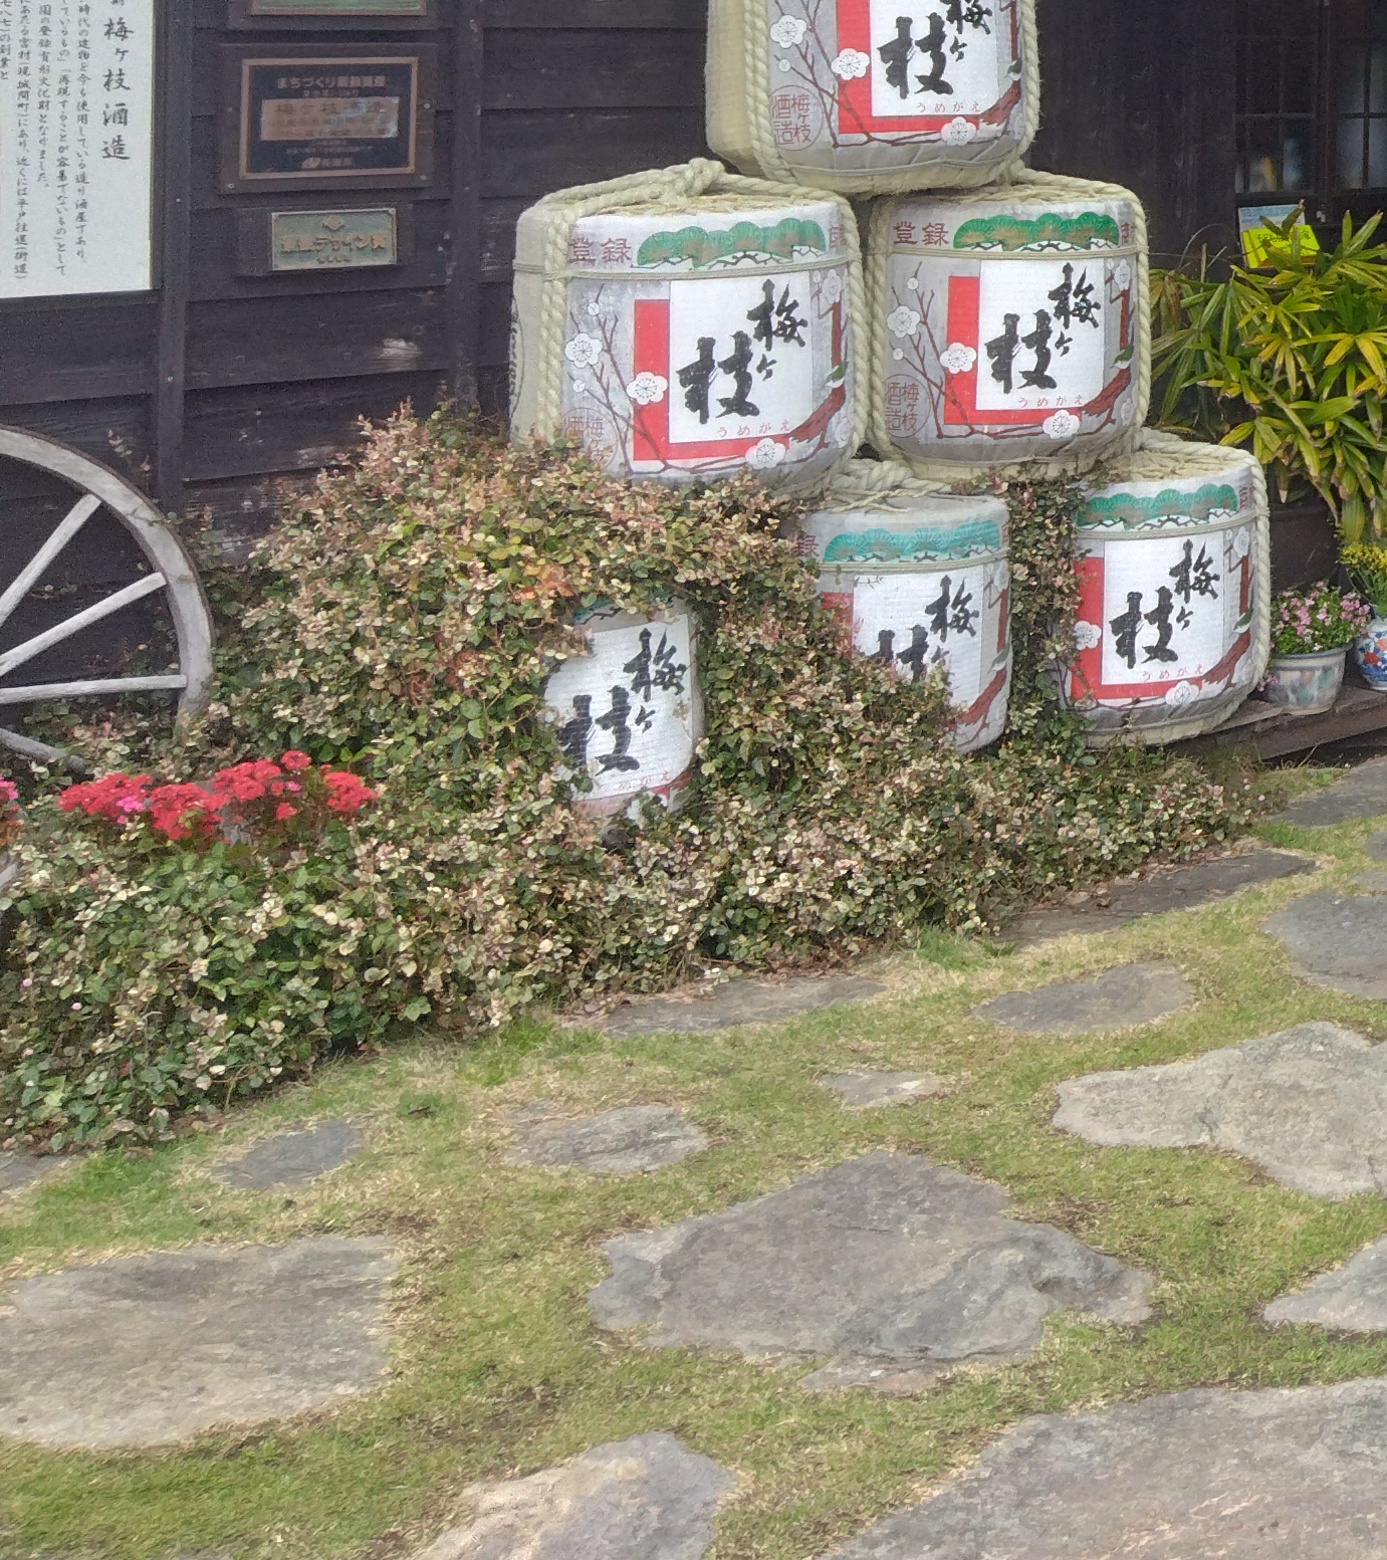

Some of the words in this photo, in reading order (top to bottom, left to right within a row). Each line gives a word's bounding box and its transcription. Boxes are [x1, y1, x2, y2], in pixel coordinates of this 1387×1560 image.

[917, 102, 981, 113] うめがえ
[772, 94, 795, 145] 酒造
[893, 221, 949, 247] 登録
[568, 236, 632, 264] 登録
[1018, 395, 1084, 408] うめがえ
[717, 420, 791, 437] うめがえ
[1141, 665, 1204, 681] うめがえ
